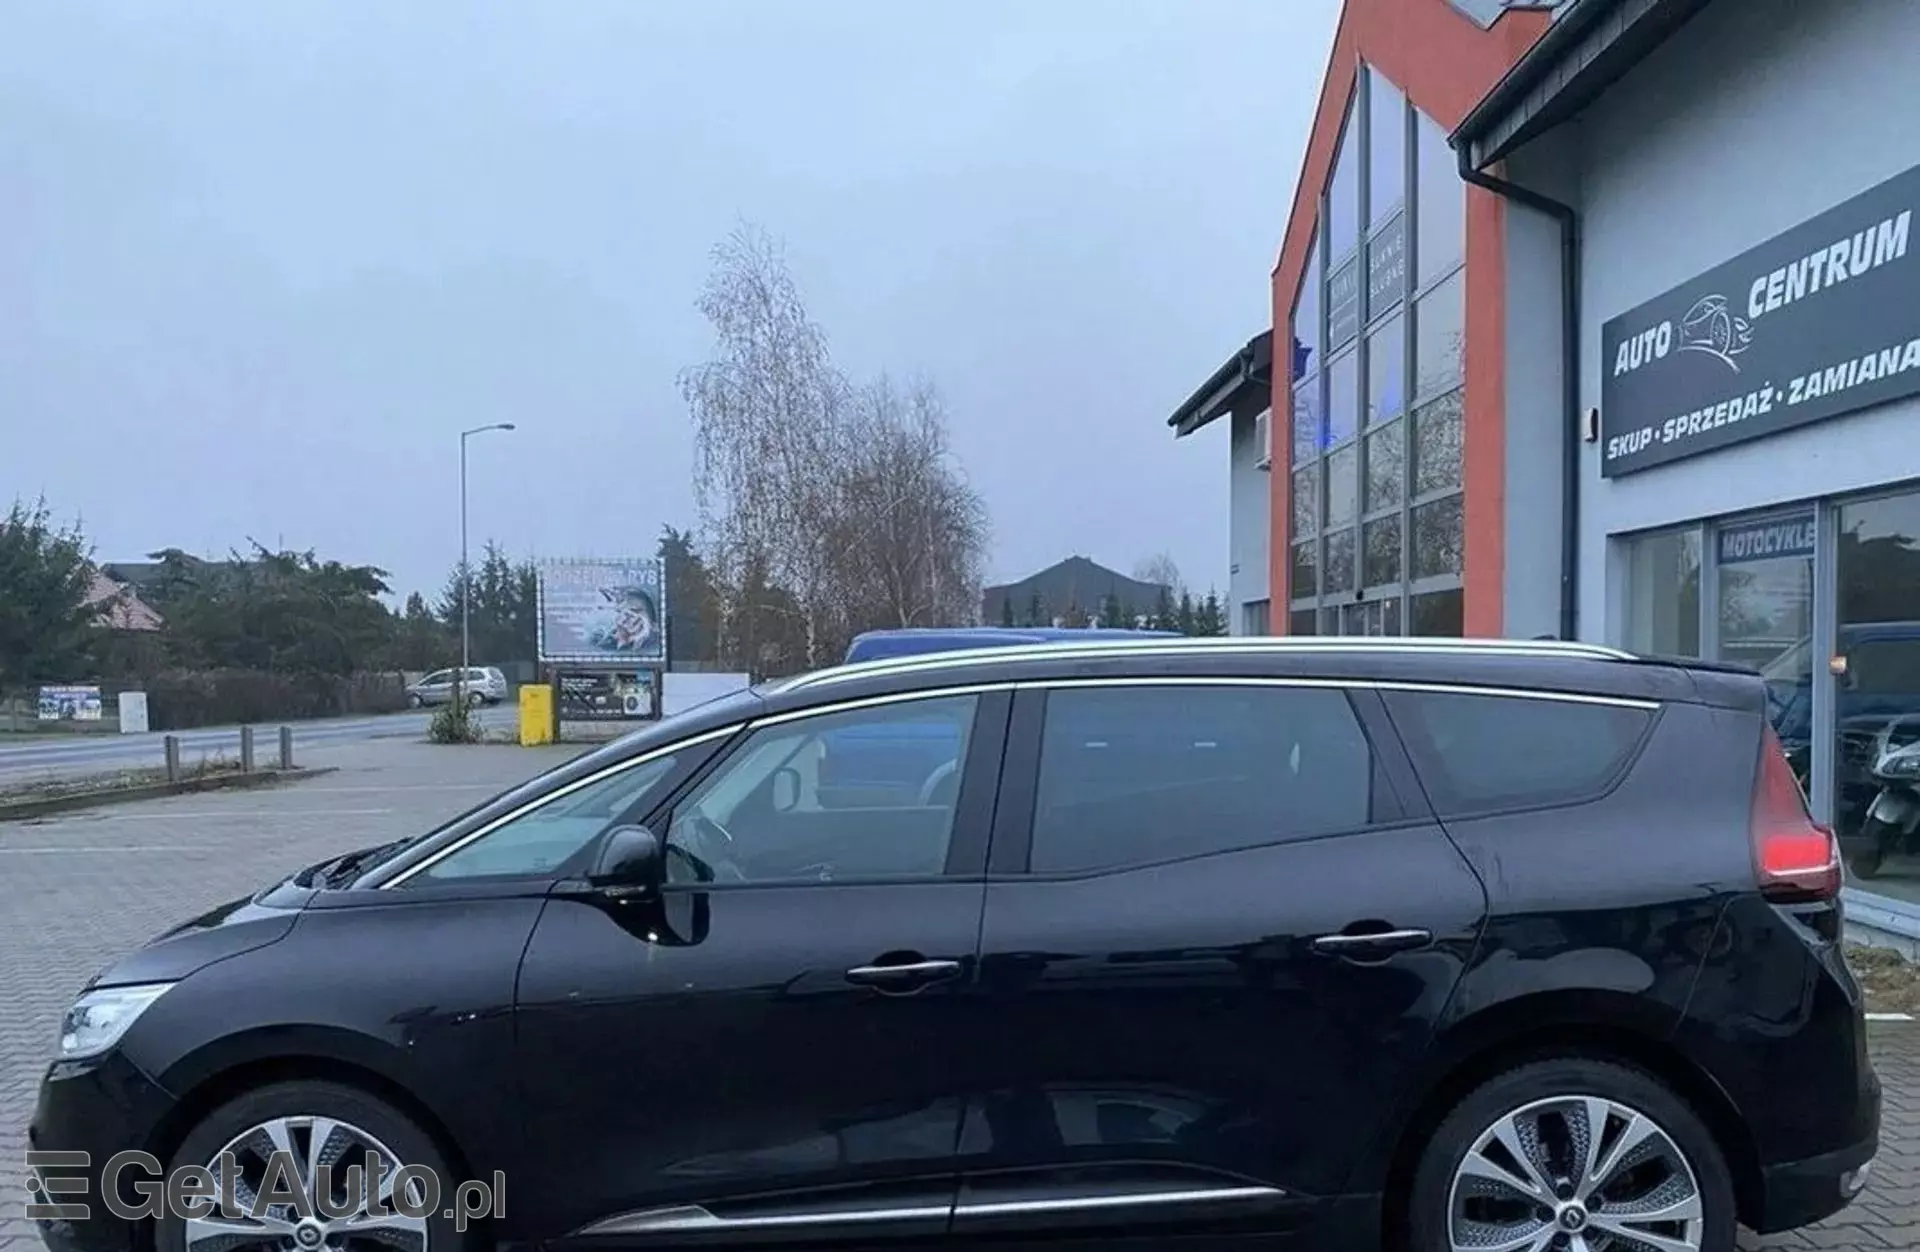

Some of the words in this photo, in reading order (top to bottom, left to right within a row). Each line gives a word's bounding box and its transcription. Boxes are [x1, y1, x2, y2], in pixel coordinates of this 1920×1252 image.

[1613, 320, 1672, 377] AUTO
[1747, 210, 1912, 320] CENTRUM
[1606, 427, 1652, 460] SKUP
[1661, 381, 1773, 445] SPRZEDAŻ
[1787, 338, 1920, 406] ZAMIANA
[1722, 521, 1815, 557] MOTOCYKLE
